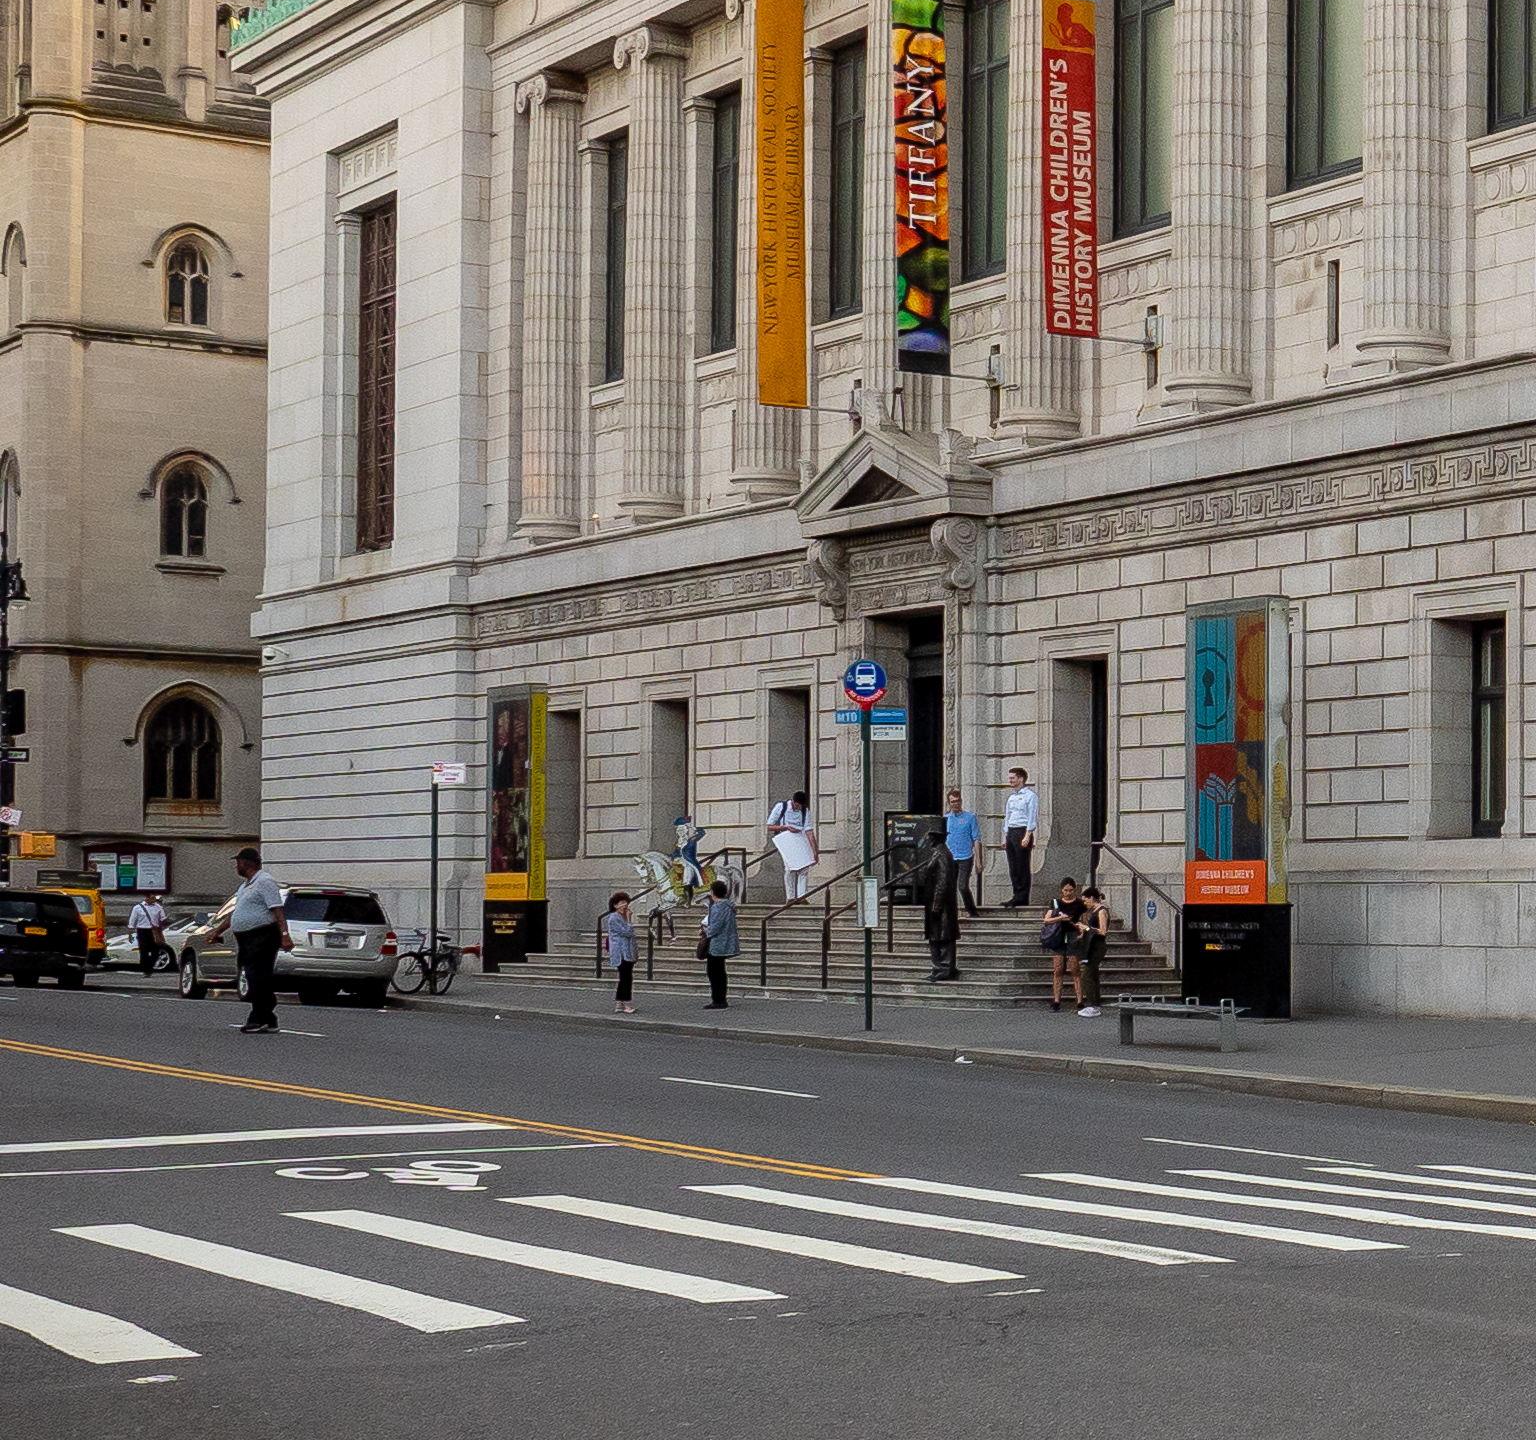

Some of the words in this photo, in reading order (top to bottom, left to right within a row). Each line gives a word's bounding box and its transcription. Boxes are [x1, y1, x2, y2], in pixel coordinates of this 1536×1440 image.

[763, 42, 777, 116] SOCIETY
[1049, 58, 1069, 202] CHILDREN'S
[763, 123, 778, 233] HISTORICAL
[784, 101, 800, 176] LIBRARY
[906, 54, 937, 230] TIFFANY
[1072, 110, 1092, 222] MUSEUM
[762, 241, 778, 335] NEW-YORK
[785, 201, 800, 280] MUSEUM
[1051, 209, 1072, 330] DIMENNA
[1073, 228, 1093, 332] HISTORY
